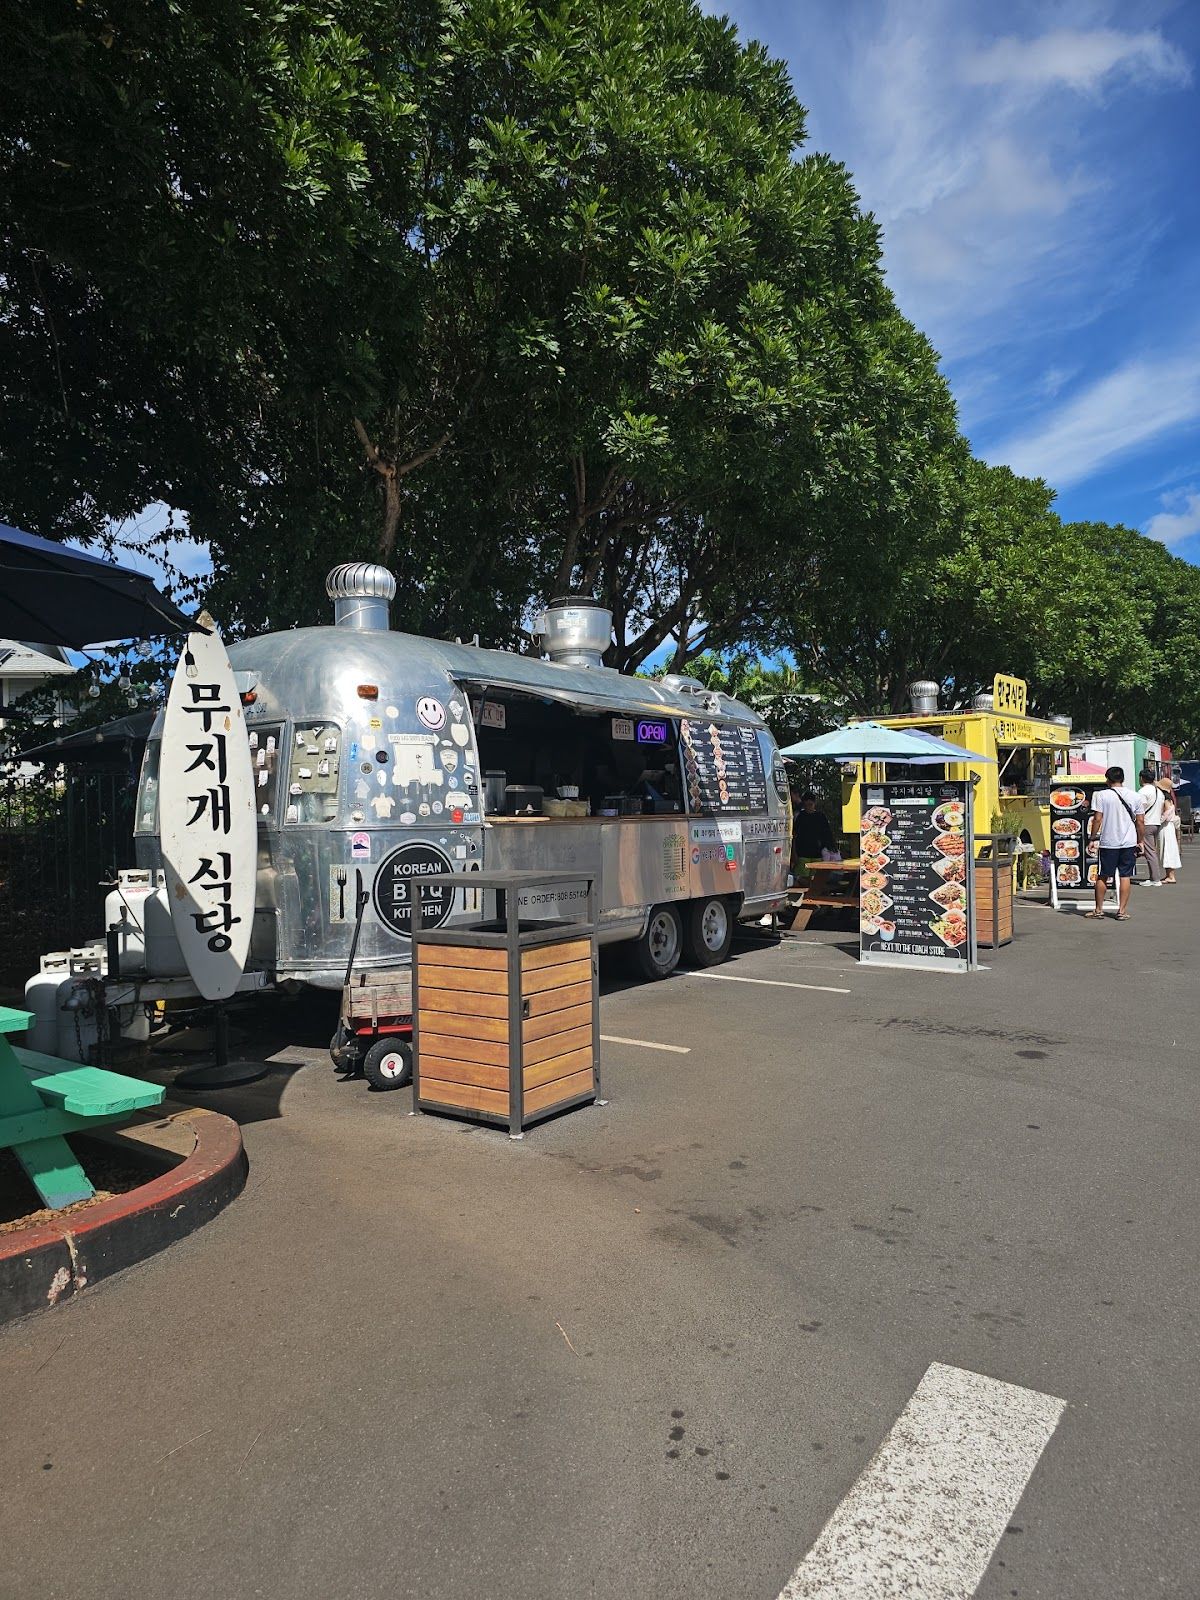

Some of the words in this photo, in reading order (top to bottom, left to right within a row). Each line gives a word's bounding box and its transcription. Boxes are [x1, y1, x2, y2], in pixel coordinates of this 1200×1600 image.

[998, 679, 1024, 712] 한국식당
[474, 706, 492, 720] PCK
[639, 723, 666, 740] OPEN
[181, 683, 231, 835] 무지개
[393, 863, 442, 875] KOREAN
[187, 852, 242, 953] 식당
[393, 904, 442, 919] KITHEN
[880, 942, 894, 952] NEXT
[895, 943, 902, 952] TO
[902, 944, 912, 954] THE
[912, 945, 929, 956] COACH
[929, 946, 946, 957] STORE
